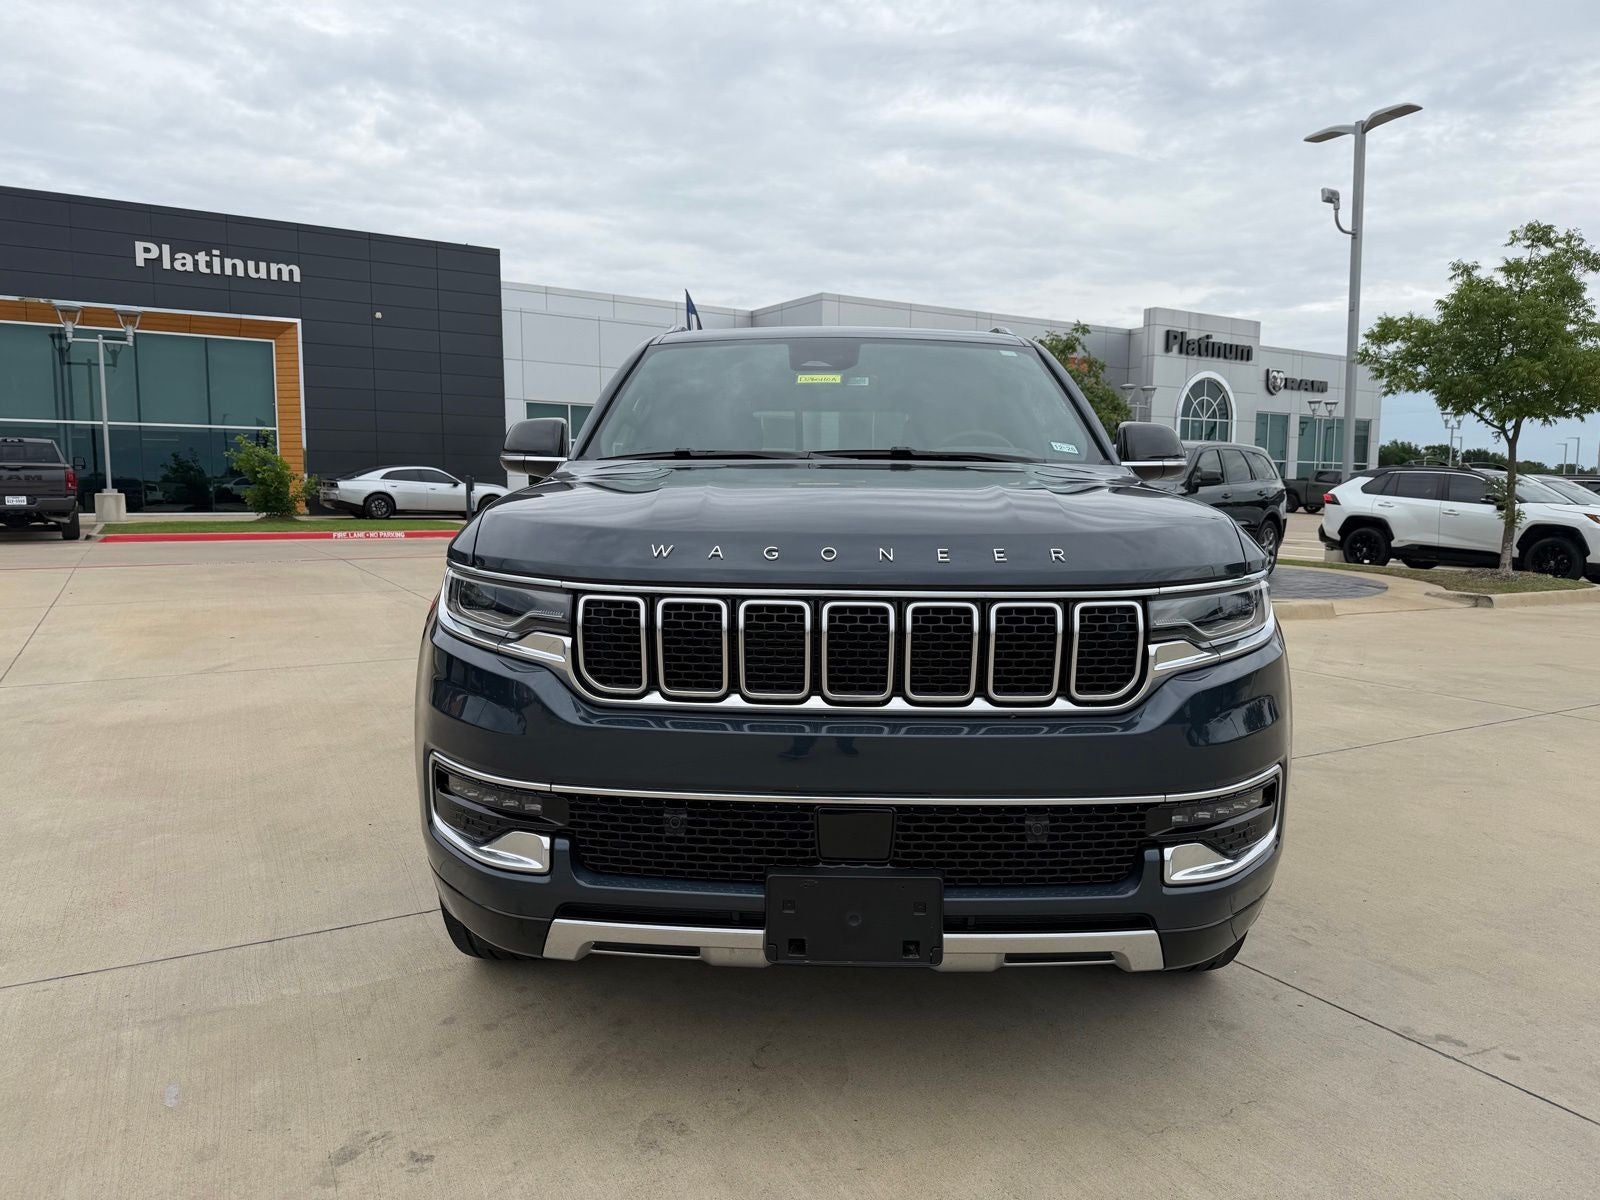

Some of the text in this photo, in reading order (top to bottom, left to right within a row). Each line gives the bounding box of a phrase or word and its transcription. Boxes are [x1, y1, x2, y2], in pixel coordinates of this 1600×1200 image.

[134, 240, 301, 283] Platinum
[1165, 329, 1253, 361] Platinum
[1284, 377, 1328, 393] RAM
[333, 531, 405, 539] FIRE LANE NO PARKING
[651, 543, 1066, 562] WAGONEER
